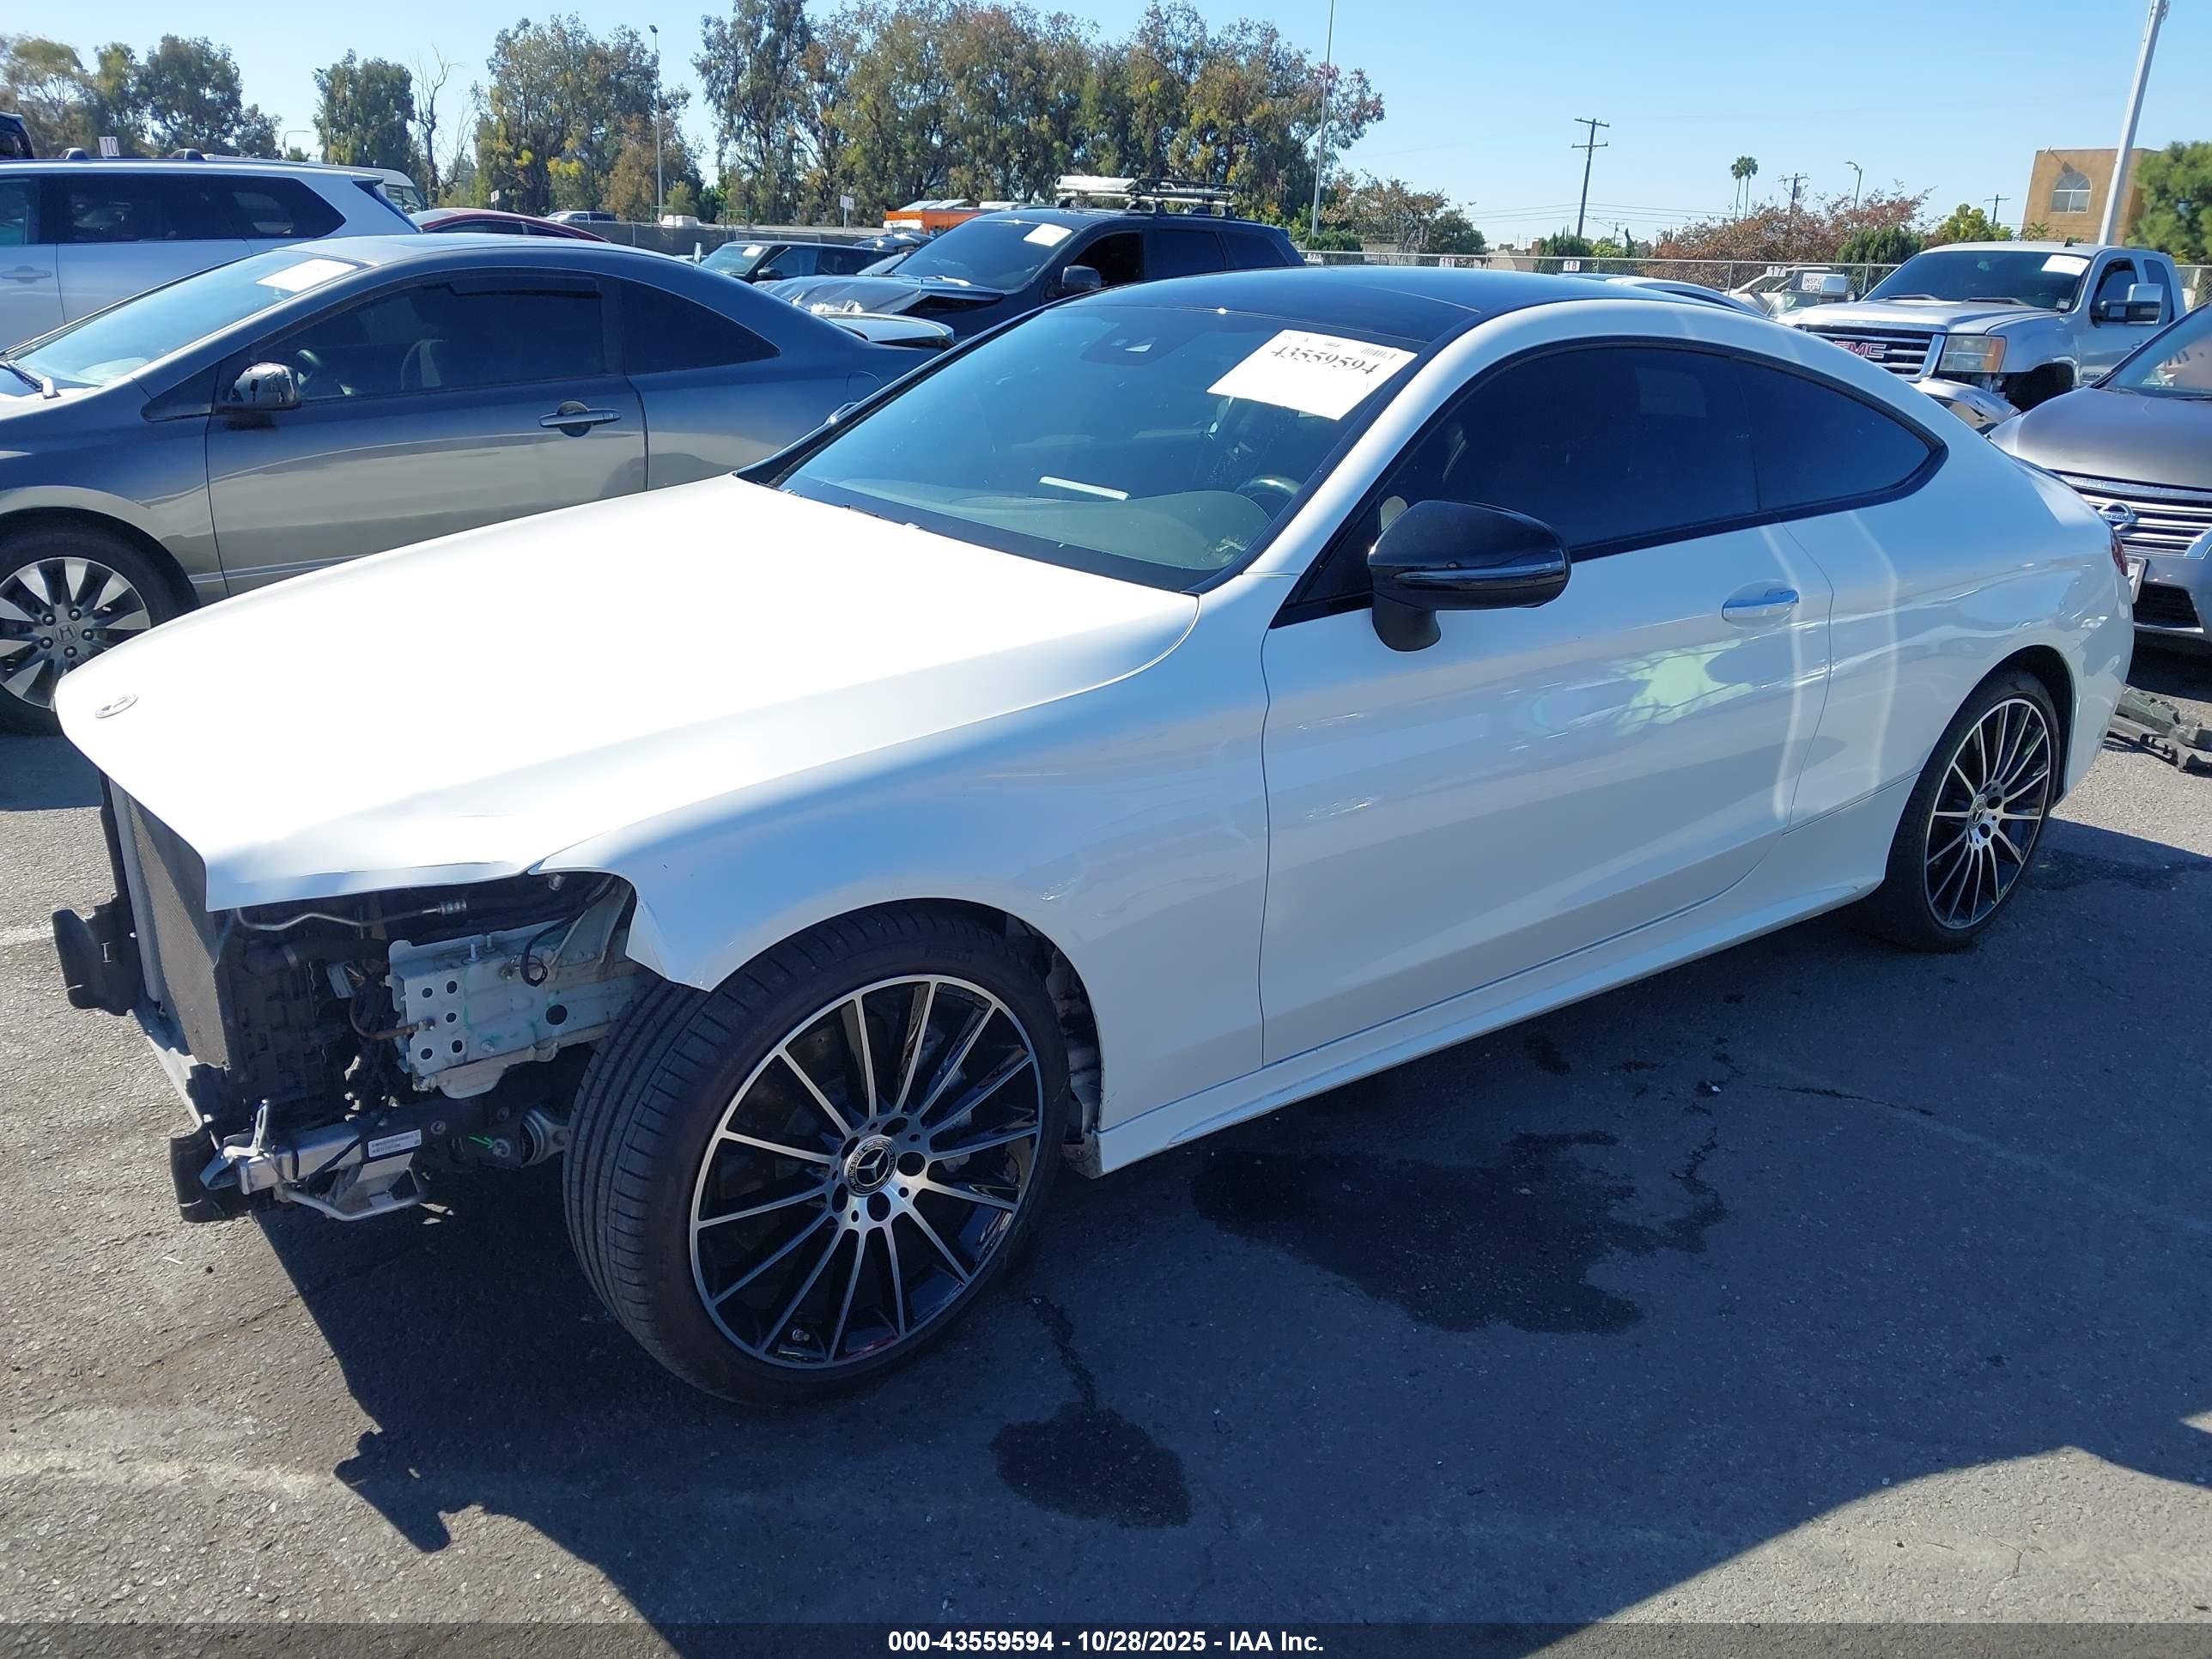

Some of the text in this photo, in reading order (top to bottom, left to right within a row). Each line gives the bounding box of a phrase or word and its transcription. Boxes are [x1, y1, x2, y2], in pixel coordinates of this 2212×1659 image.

[104, 137, 118, 155] 10
[1565, 260, 1577, 270] 18
[1770, 266, 1784, 276] 17
[1271, 345, 1380, 374] 43559594
